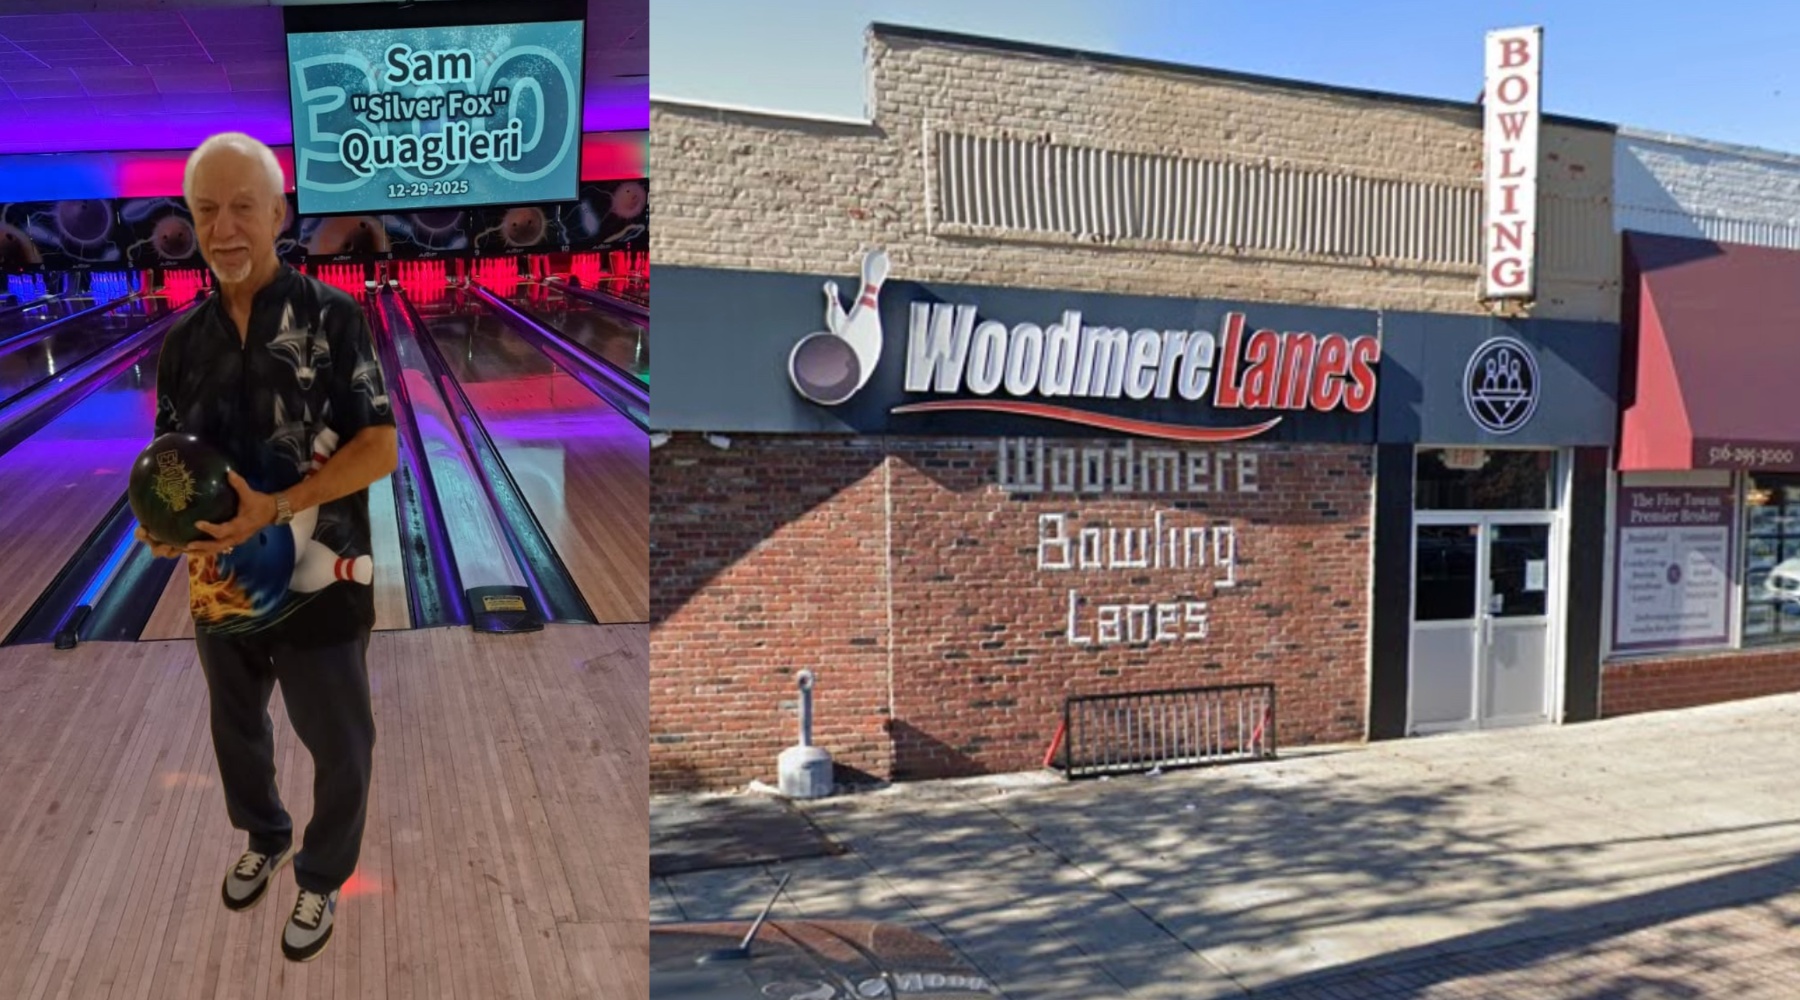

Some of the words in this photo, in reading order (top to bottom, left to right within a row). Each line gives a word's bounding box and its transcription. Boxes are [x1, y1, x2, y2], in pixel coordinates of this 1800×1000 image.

[386, 45, 473, 84] Sam
[352, 95, 443, 122] "Silver
[448, 90, 508, 117] Fox"
[341, 120, 521, 175] Quaglieri
[1491, 38, 1531, 288] BOWLING
[386, 180, 470, 199] 12-29-2025
[905, 302, 1215, 400] Woodmere
[1214, 312, 1380, 412] Lanes
[1000, 437, 1259, 493] Woodmere
[1630, 508, 1680, 523] Premier
[1681, 508, 1721, 522] Broker
[1632, 493, 1655, 507] The
[1657, 493, 1681, 506] Five
[1683, 493, 1721, 506] Towns
[1037, 510, 1237, 588] Bowling
[1068, 589, 1209, 646] Lanes
